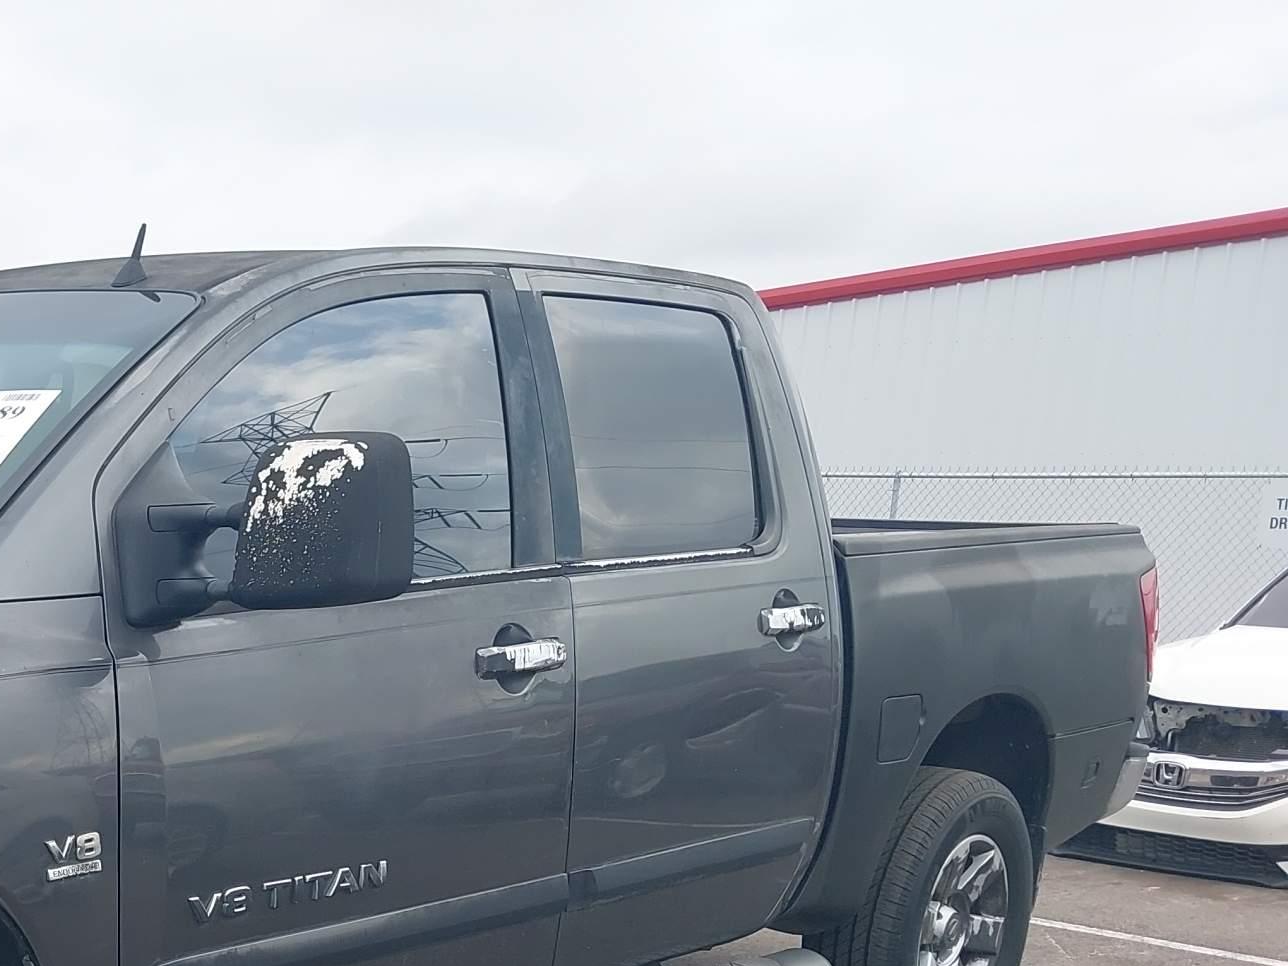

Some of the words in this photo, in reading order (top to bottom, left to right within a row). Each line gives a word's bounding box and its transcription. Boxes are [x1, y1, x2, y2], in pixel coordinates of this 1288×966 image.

[1270, 517, 1288, 530] DR
[43, 832, 102, 864] V8
[188, 886, 252, 923] V8
[263, 860, 389, 910] TITAN
